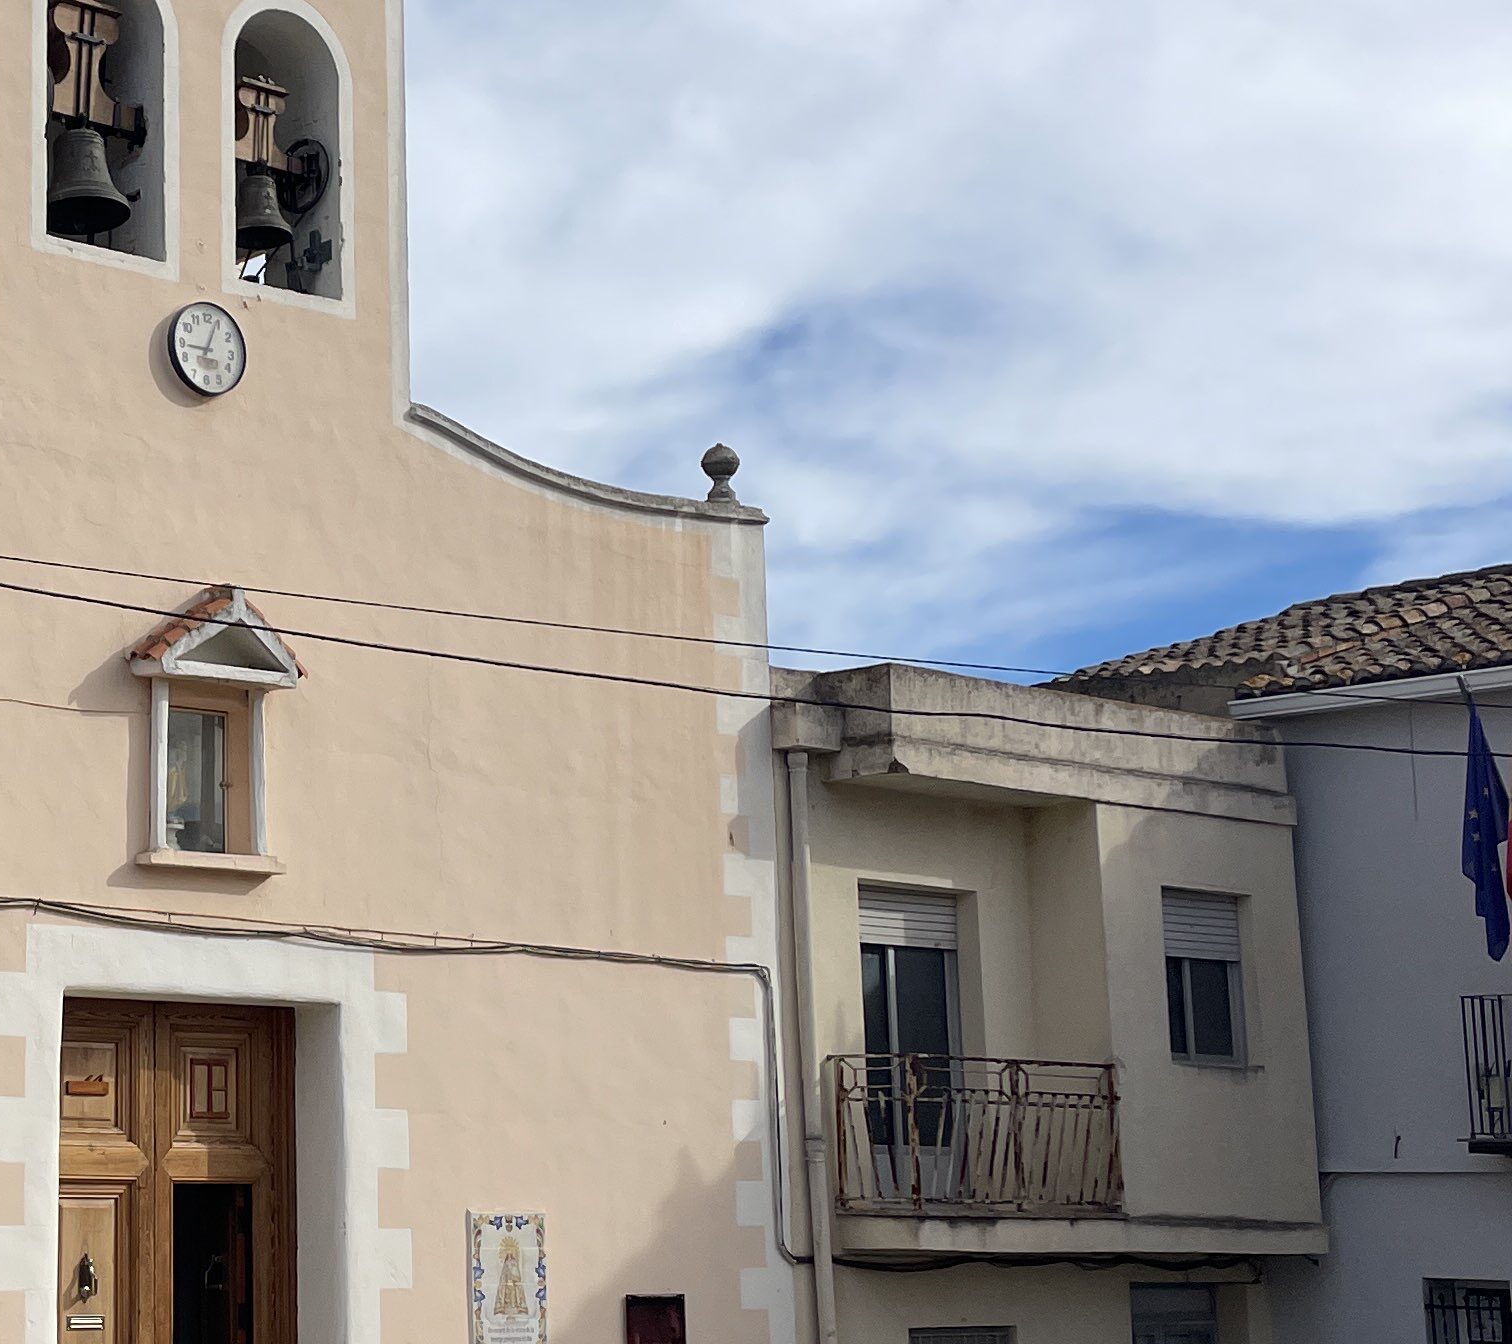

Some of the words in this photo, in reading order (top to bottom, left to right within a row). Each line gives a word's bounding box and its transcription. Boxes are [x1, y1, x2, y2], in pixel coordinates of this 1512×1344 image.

[191, 314, 199, 325] 11
[203, 313, 212, 324] 12
[183, 322, 192, 333] 10
[179, 337, 185, 348] 9
[225, 332, 231, 343] 2
[182, 352, 188, 362] 8
[228, 350, 234, 361] 3
[225, 363, 231, 373] 4
[191, 369, 197, 379] 7
[216, 374, 222, 385] 5
[204, 375, 210, 385] 6
